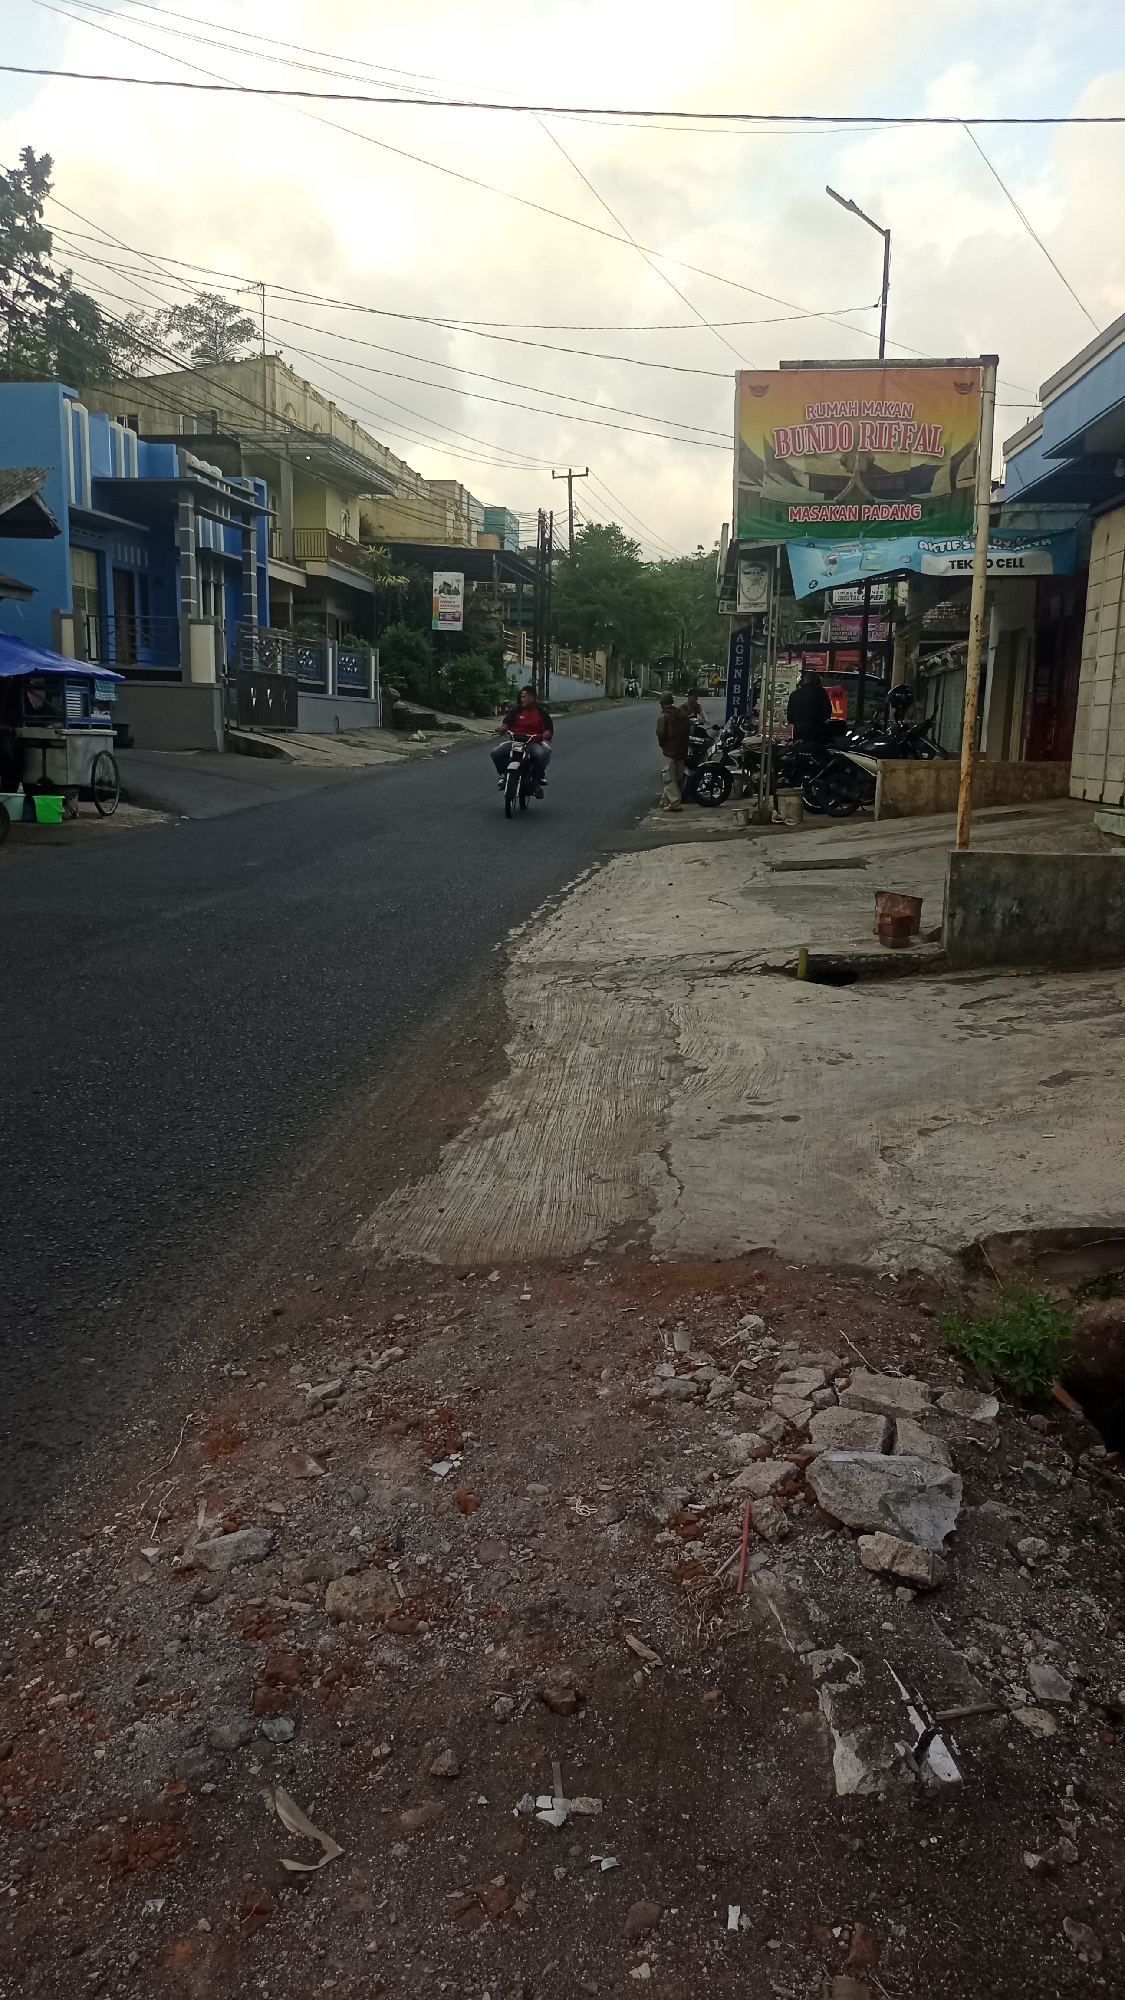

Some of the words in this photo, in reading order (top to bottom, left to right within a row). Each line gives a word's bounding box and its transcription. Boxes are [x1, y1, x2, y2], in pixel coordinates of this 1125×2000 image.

[805, 401, 859, 420] RUMAH
[861, 401, 914, 418] MAKAN
[773, 421, 854, 459] BUNDO
[858, 420, 945, 457] RIFFAL
[789, 505, 859, 522] MASAKAN
[861, 504, 921, 520] PADANG
[919, 540, 961, 552] AKTIF
[949, 559, 994, 569] TEKO
[996, 557, 1025, 568] CELL
[734, 633, 744, 678] AGEN
[732, 684, 741, 717] BRI
